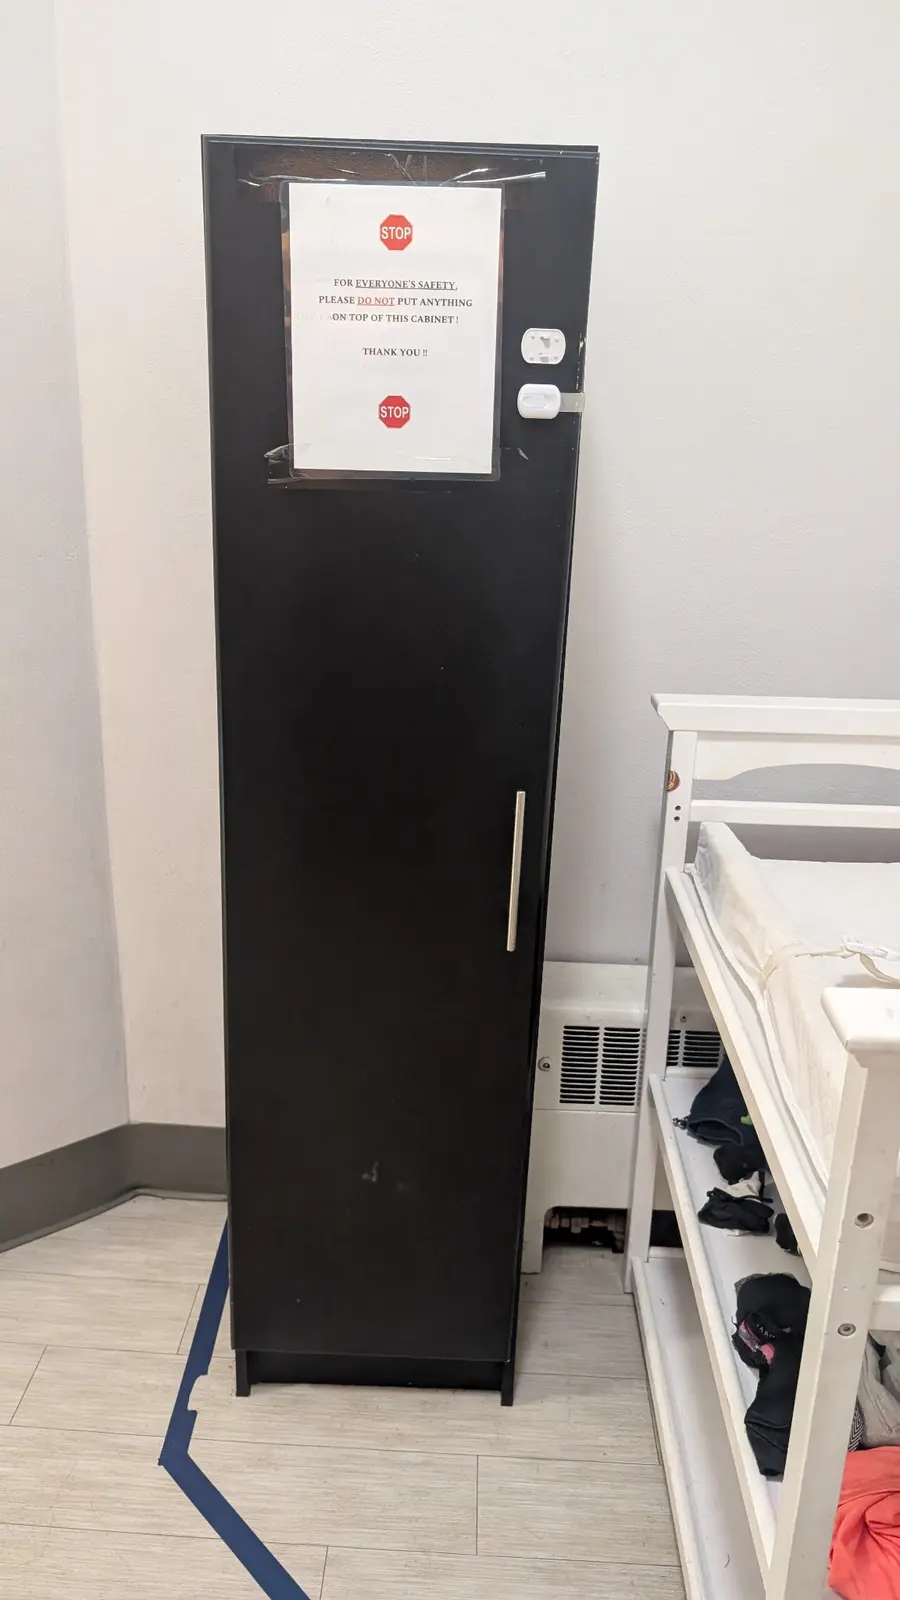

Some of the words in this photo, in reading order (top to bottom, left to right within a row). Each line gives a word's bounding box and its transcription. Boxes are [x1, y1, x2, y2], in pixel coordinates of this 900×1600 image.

[381, 226, 411, 240] STOP
[333, 278, 354, 287] FOR
[355, 279, 416, 290] EVERYONE'S
[417, 280, 458, 291] SAFETY,
[318, 295, 356, 304] PLEASE
[356, 296, 373, 306] DO
[373, 296, 396, 306] NOT
[396, 297, 418, 306] PUT
[419, 298, 473, 307] ANYTHING
[332, 312, 347, 321] ON
[348, 313, 369, 322] TOP
[370, 313, 384, 322] OF
[385, 314, 409, 323] THIS
[410, 314, 454, 324] CABINET
[361, 347, 398, 356] THANK
[399, 348, 421, 357] YOU
[380, 405, 409, 419] STOP
